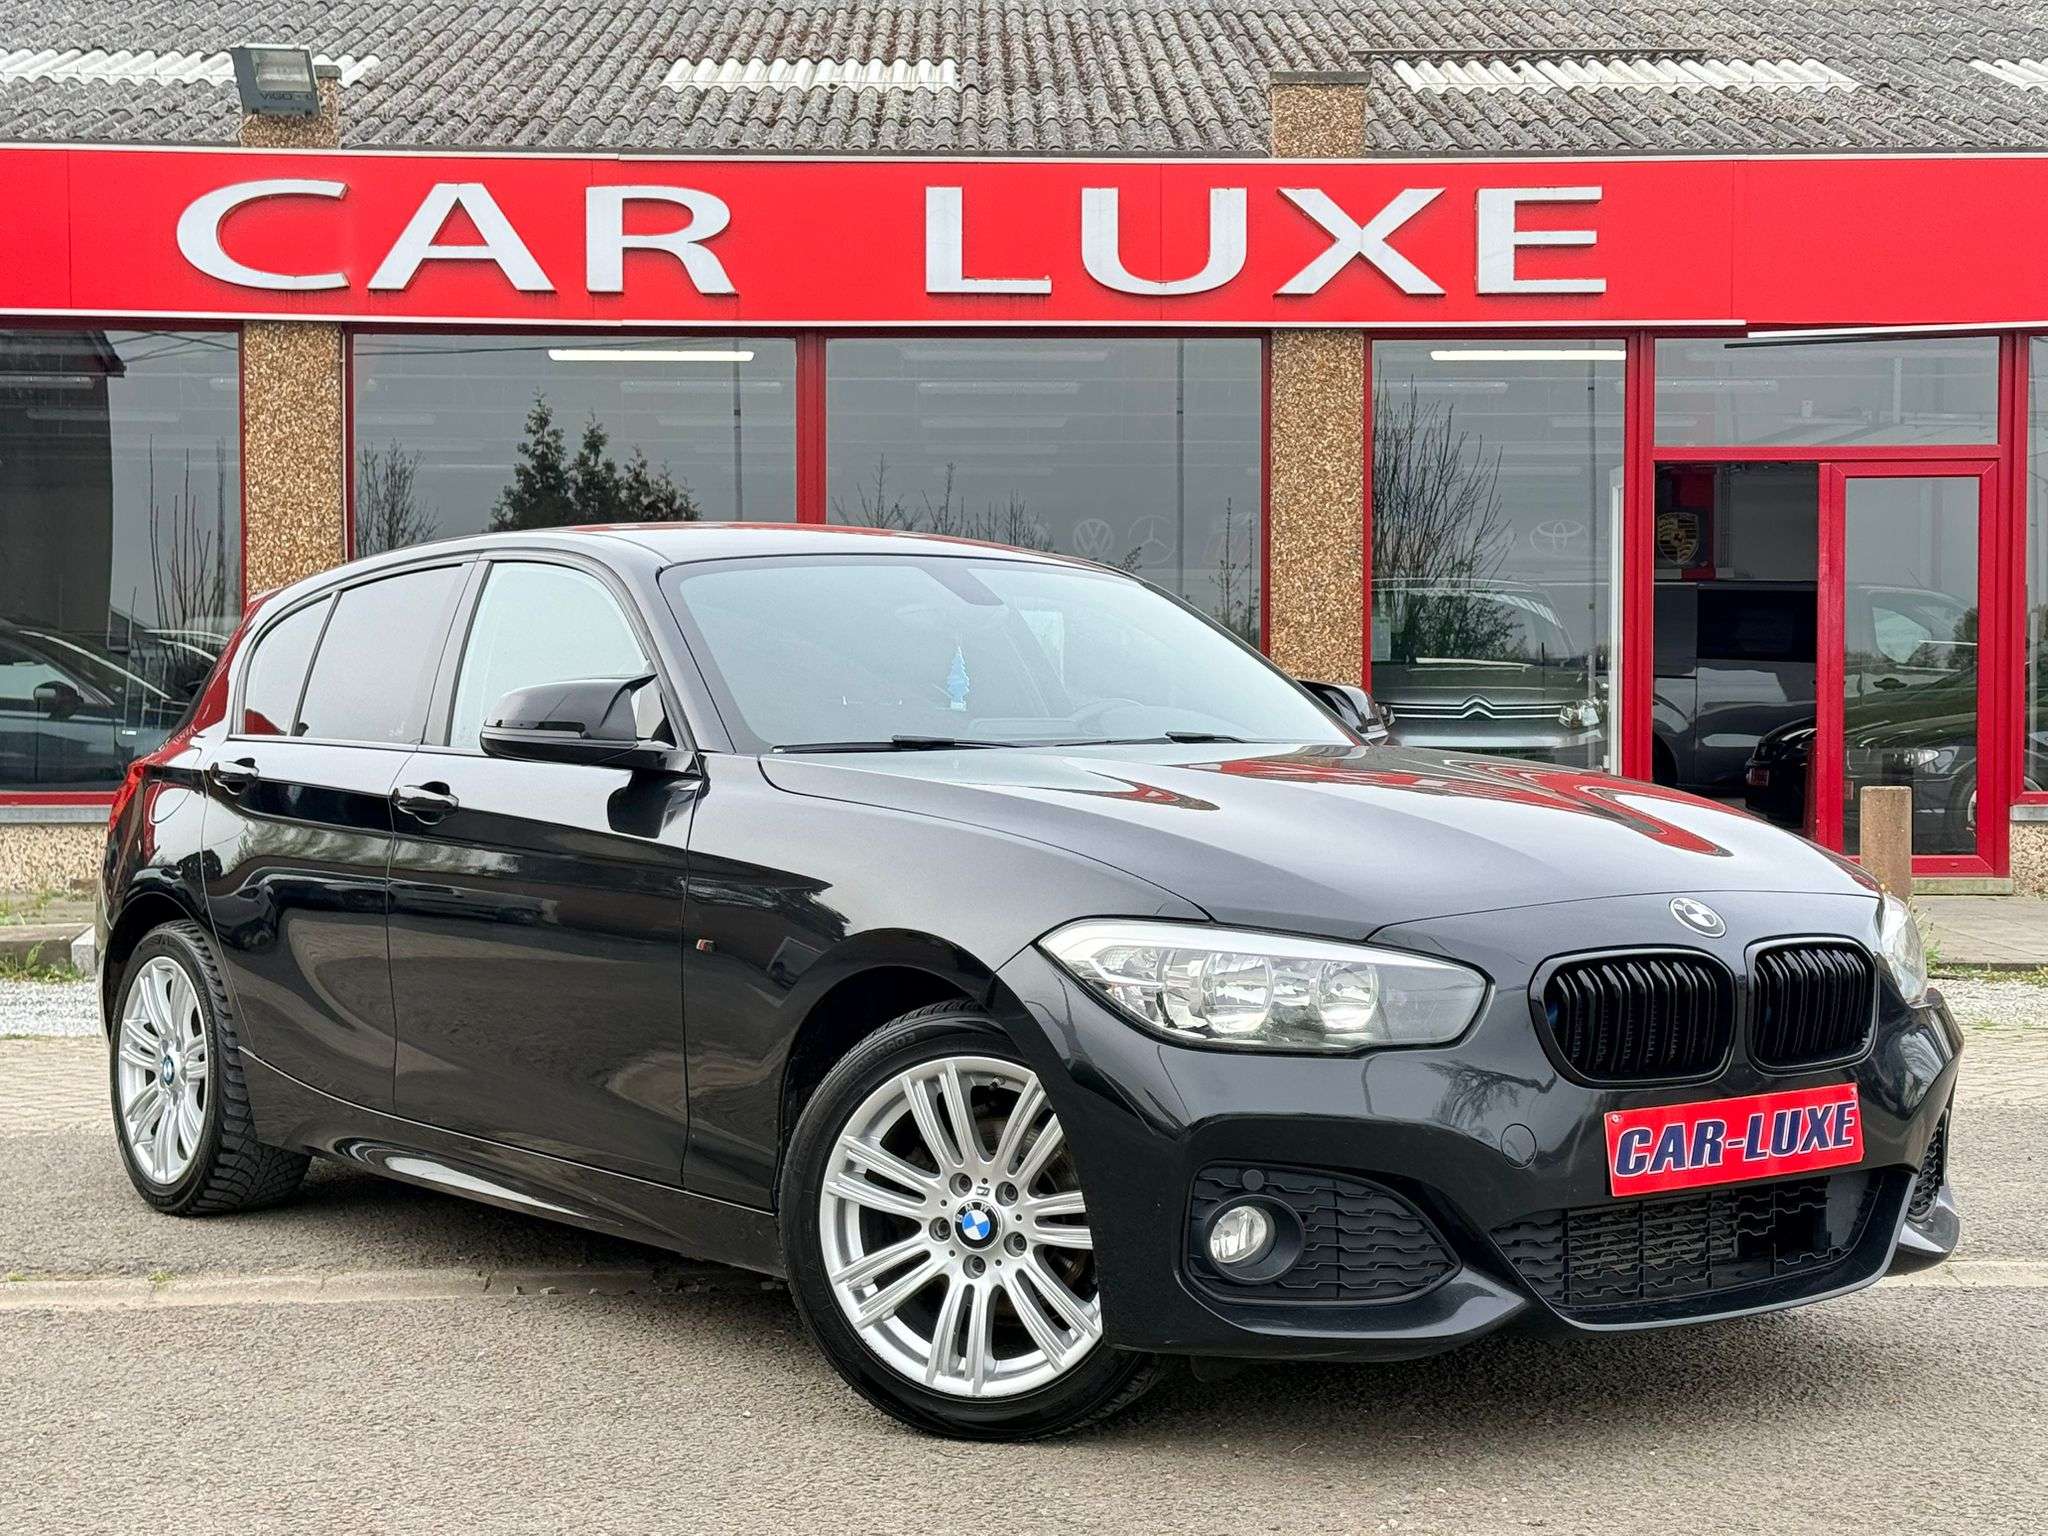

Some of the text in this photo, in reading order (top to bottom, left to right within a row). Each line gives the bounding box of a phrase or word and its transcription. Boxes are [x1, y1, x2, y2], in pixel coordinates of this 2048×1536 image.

[176, 178, 1608, 297] CAR LUXE
[1614, 1101, 1858, 1178] CAR-LUXE
